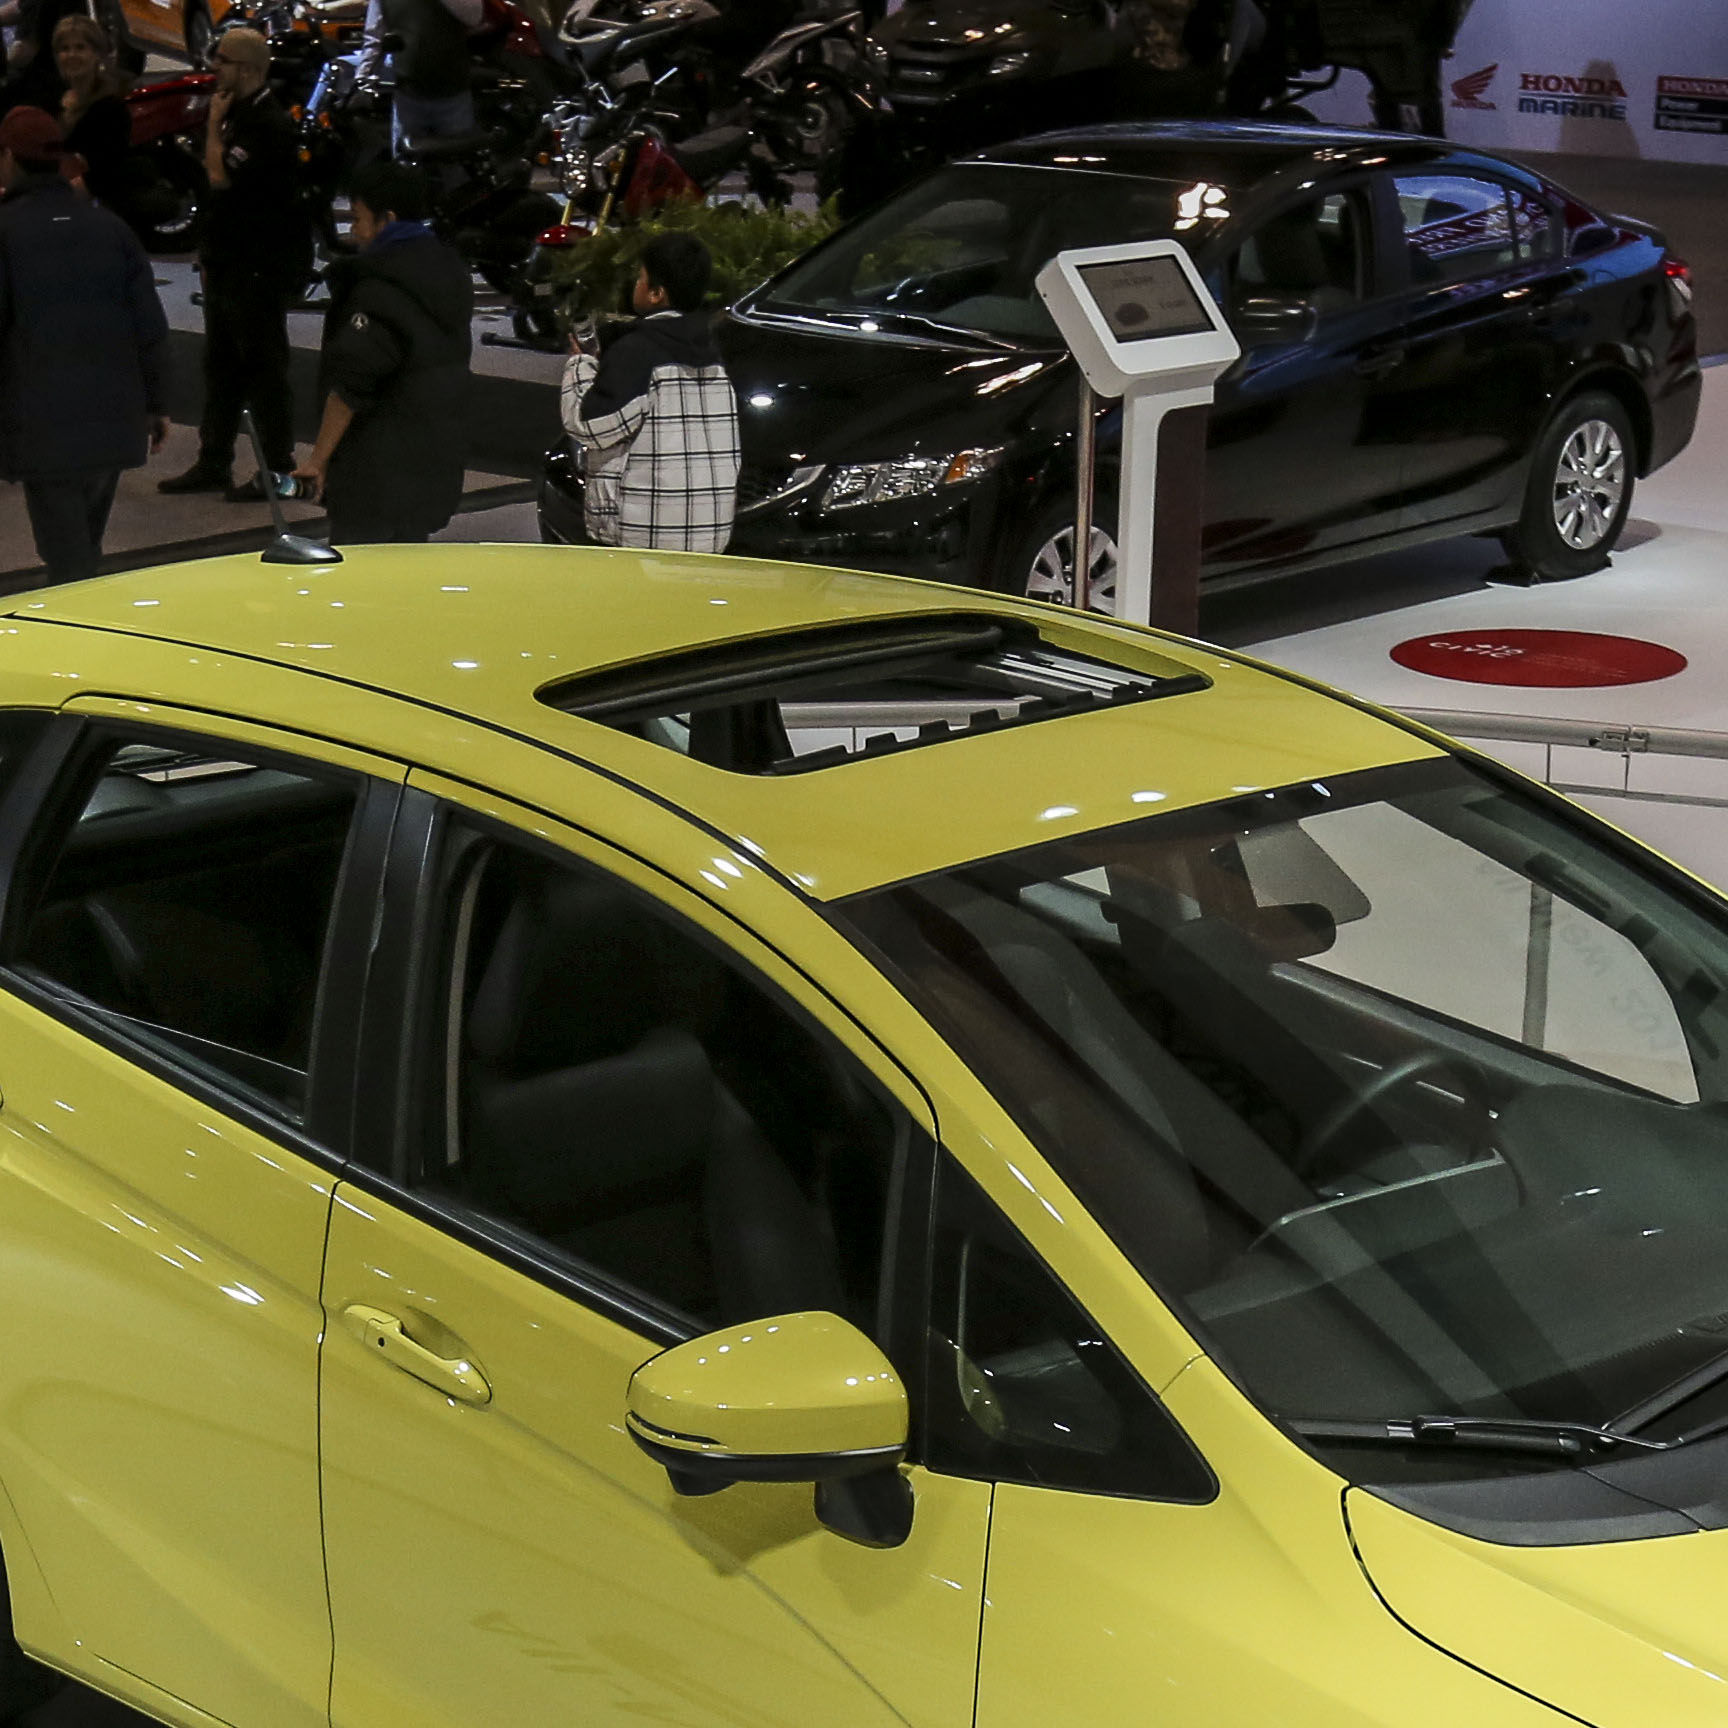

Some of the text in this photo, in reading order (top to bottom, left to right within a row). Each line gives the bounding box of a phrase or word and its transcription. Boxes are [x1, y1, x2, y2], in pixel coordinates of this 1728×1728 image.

[1519, 73, 1628, 97] HONDA
[1518, 98, 1627, 120] MARINE
[1429, 642, 1512, 659] CIVIC
